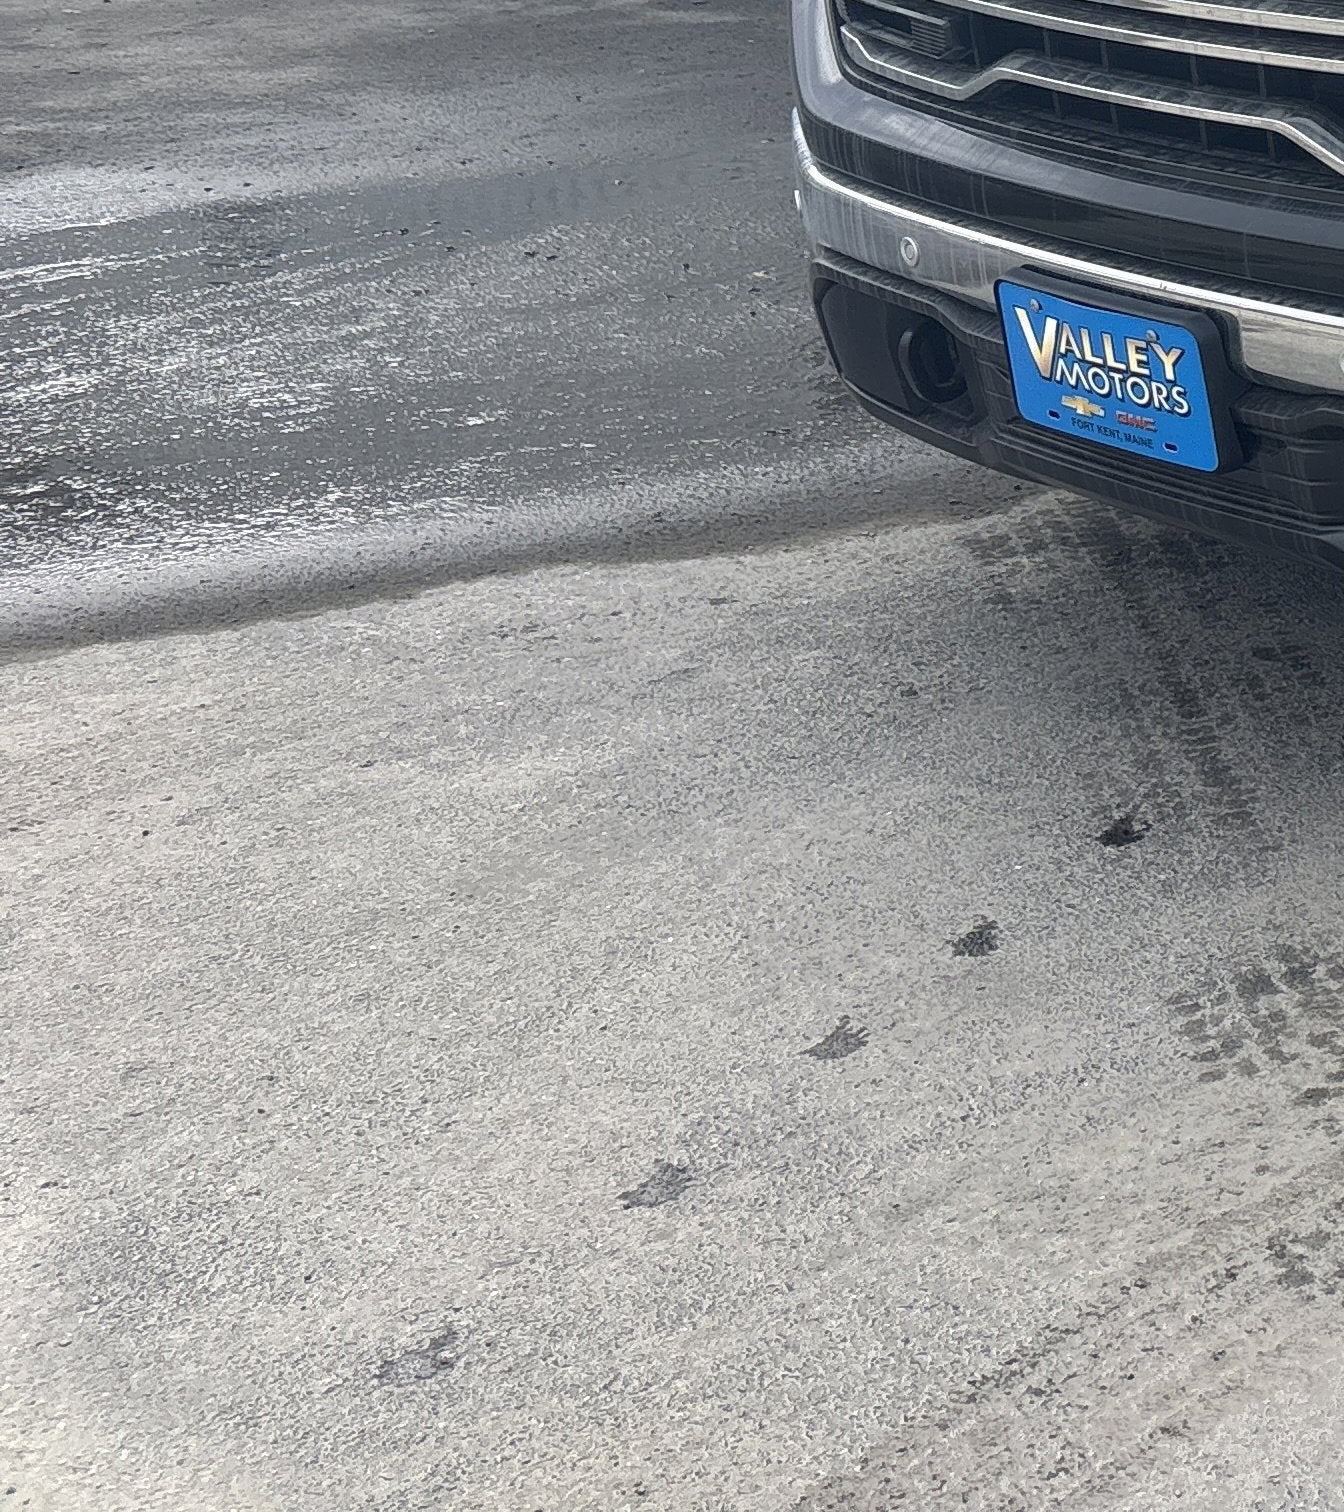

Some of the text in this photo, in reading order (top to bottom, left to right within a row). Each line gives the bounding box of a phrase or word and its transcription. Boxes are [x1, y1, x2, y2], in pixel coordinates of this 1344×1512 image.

[1013, 304, 1185, 382] VALLEY
[1055, 358, 1191, 416] MOTORS
[1071, 416, 1095, 432] FORT
[1124, 433, 1155, 449] MAINE
[1115, 410, 1158, 433] GMC
